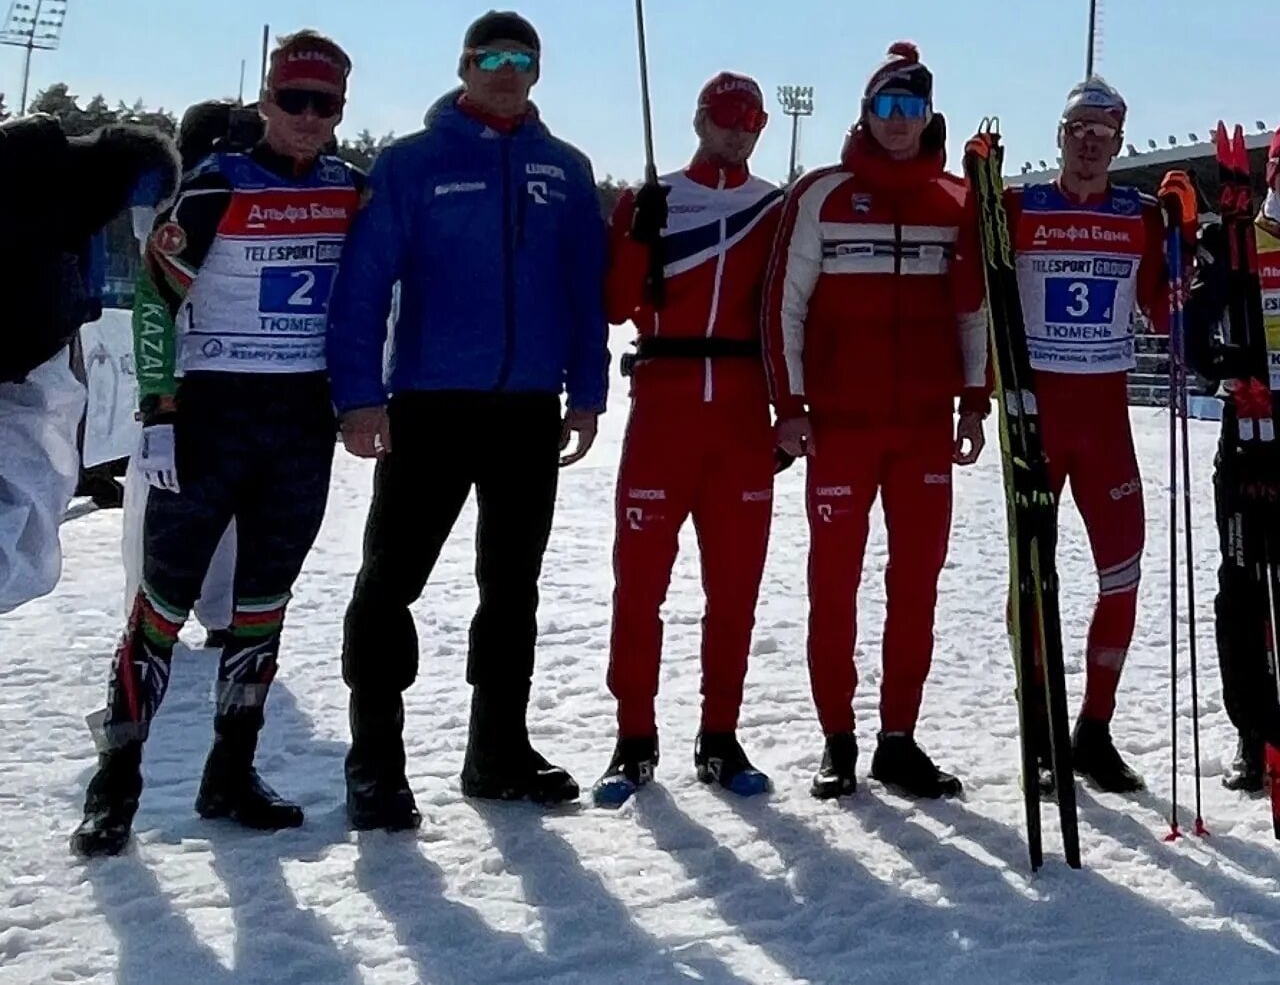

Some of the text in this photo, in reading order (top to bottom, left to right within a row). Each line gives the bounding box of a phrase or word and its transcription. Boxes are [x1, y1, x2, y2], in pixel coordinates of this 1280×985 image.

[248, 204, 308, 224] Альфа
[1034, 224, 1131, 243] Альфа Банк
[245, 245, 315, 262] TELESPORT
[1031, 259, 1131, 277] TELESPORT GROUP
[288, 270, 316, 306] 2
[1066, 282, 1090, 317] 3
[1045, 325, 1112, 339] ТЮМЕНЬ
